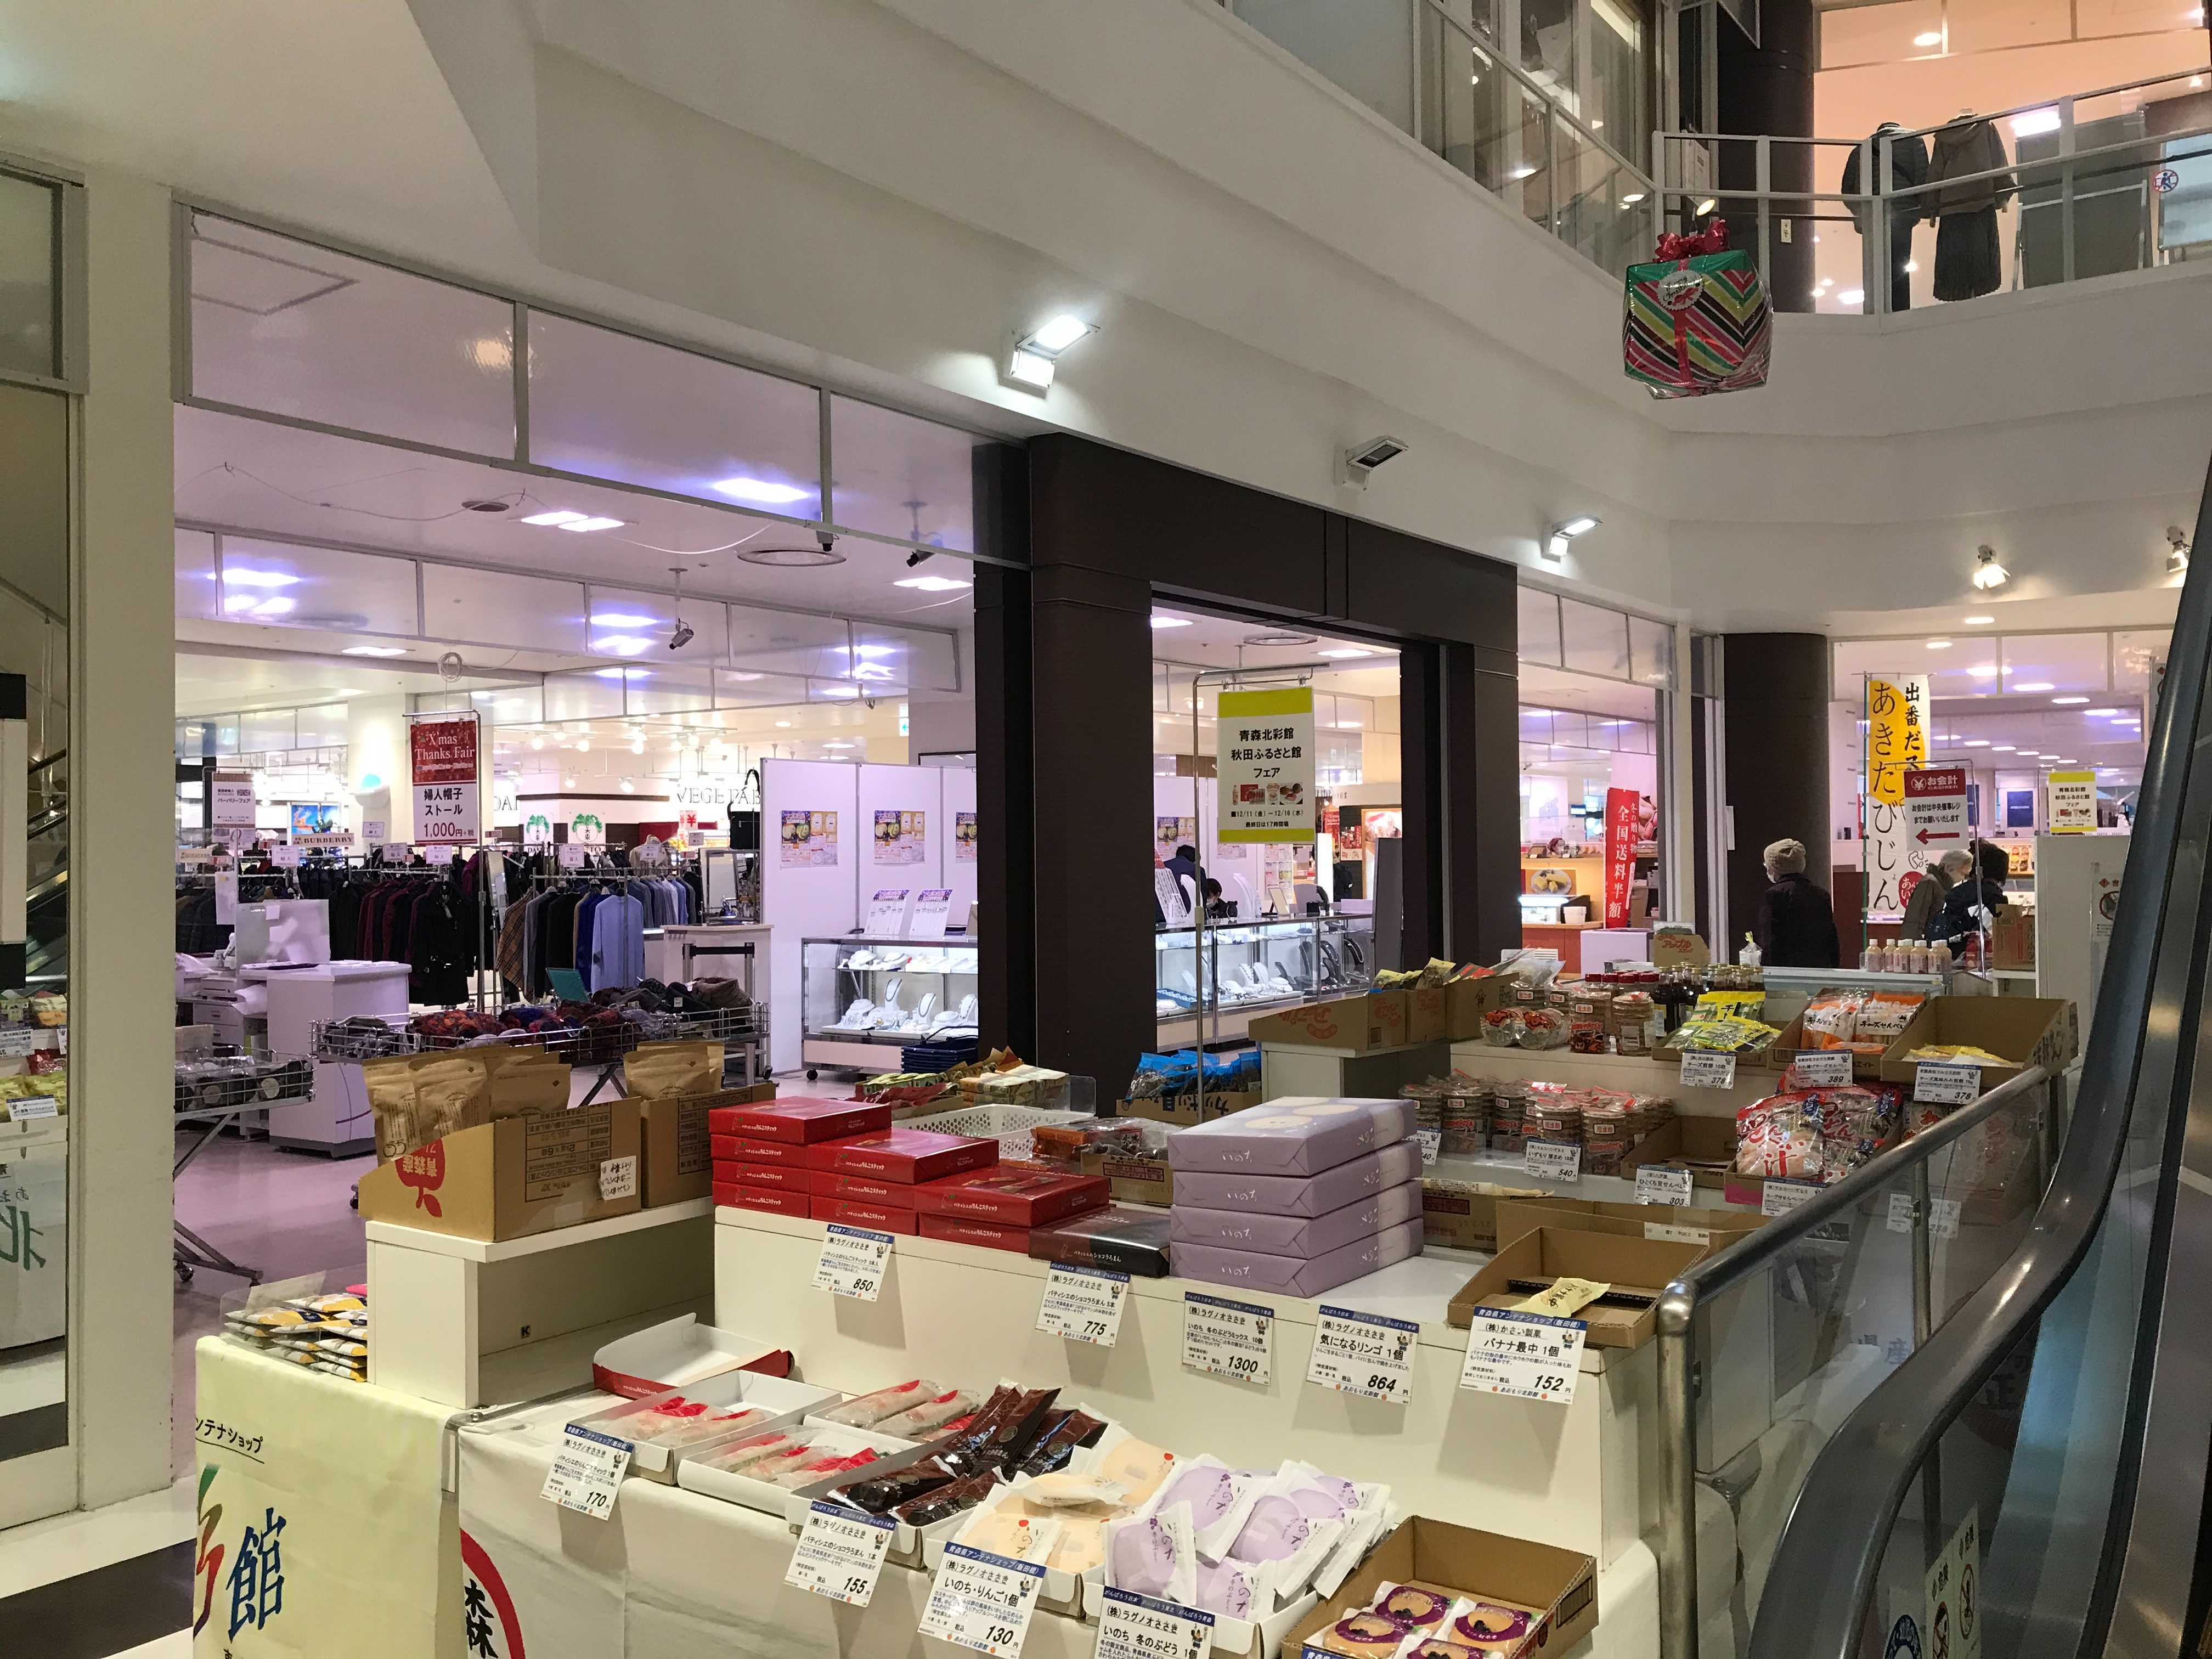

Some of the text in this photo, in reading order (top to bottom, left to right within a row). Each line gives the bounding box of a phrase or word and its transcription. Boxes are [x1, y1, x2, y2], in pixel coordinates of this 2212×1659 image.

[428, 731, 458, 746] X'mas
[1239, 728, 1294, 742] 青森北彩館
[414, 746, 475, 761] Thanks Fair
[1231, 746, 1301, 761] 秋田ふるさと館
[1253, 768, 1280, 778] フェア
[1927, 775, 1959, 786] お会計
[424, 788, 463, 801] 婦人帽子
[425, 804, 463, 816] ストール
[1608, 804, 1629, 919] 全国送料半額
[1222, 1150, 1252, 1163] いのち
[1558, 1169, 1573, 1177] 540
[1227, 1189, 1257, 1201] いのち
[1669, 1197, 1685, 1205] 303
[1222, 1228, 1252, 1240] いのち
[1221, 1265, 1251, 1278] いのち
[853, 1278, 873, 1291] 850
[1048, 1290, 1105, 1306] パティシエのショコラろまん
[1084, 1321, 1107, 1335] 775
[1188, 1323, 1203, 1331] いのち
[1207, 1327, 1249, 1341] 冬のぶどうミックス
[1320, 1334, 1404, 1361] 気になるリンゴ 1個
[1484, 1338, 1560, 1357] バナナ最中 1個
[1228, 1356, 1258, 1373] 1300
[1368, 1374, 1397, 1392] 864
[1534, 1374, 1564, 1392] 152
[586, 1491, 607, 1507] 170
[804, 1536, 877, 1561] パティシエのショコラろまん 1本
[843, 1576, 868, 1594] 155
[945, 1577, 1019, 1607] いのち・りんご1個
[985, 1625, 1014, 1645] 130
[1104, 1625, 1130, 1641] いのち
[1136, 1634, 1178, 1655] 冬のぶどう
